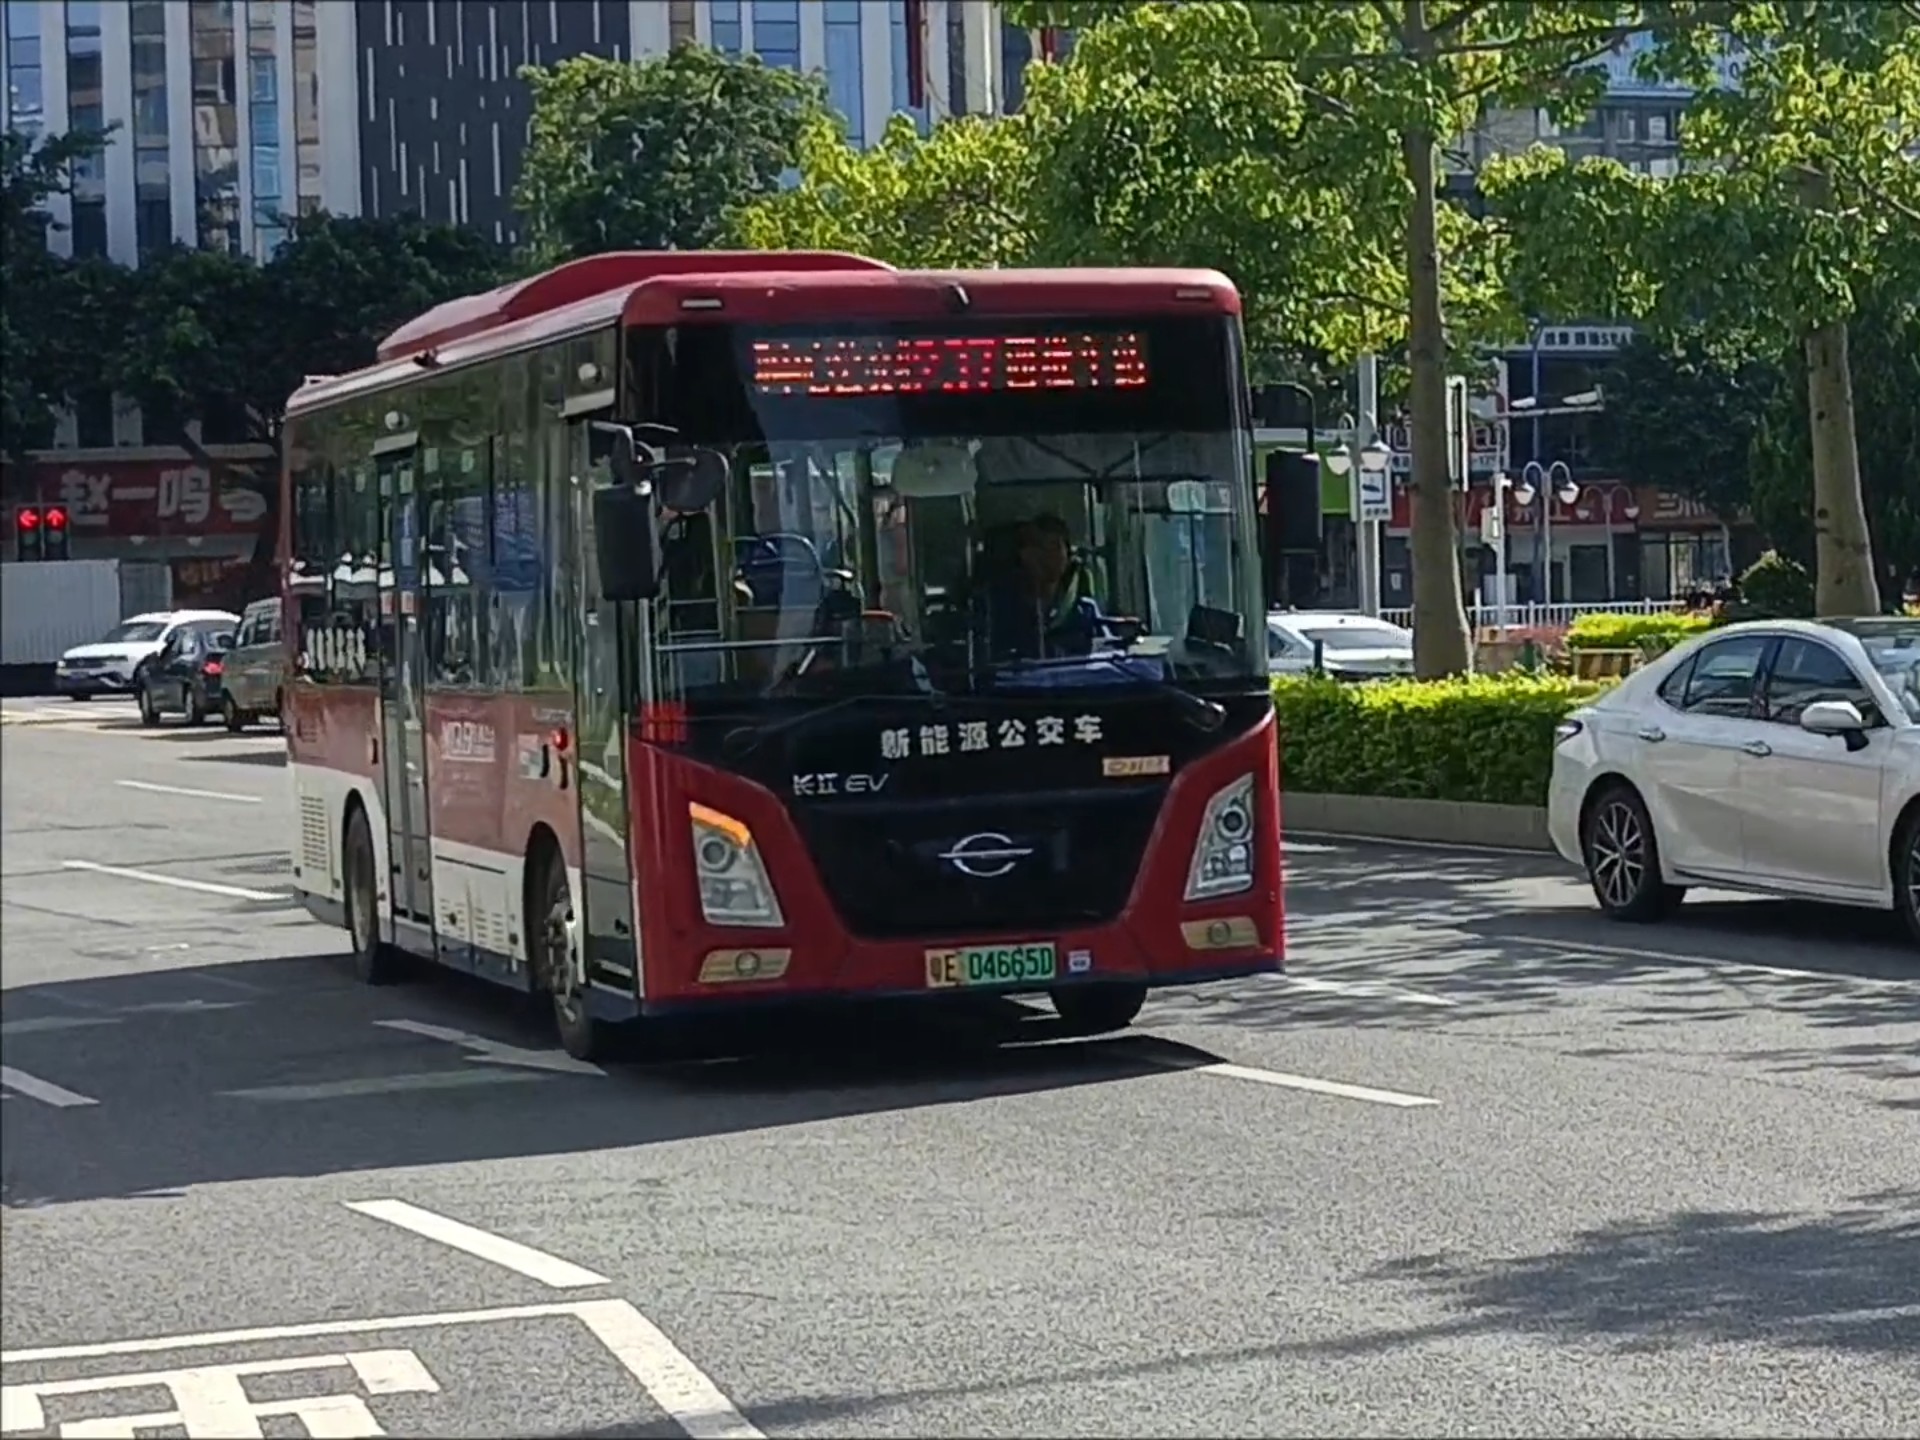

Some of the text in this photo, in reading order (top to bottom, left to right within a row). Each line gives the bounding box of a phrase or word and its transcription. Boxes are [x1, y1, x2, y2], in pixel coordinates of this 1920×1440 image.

[880, 714, 1104, 759] 新能源公交车
[793, 772, 890, 796] 长江 EV
